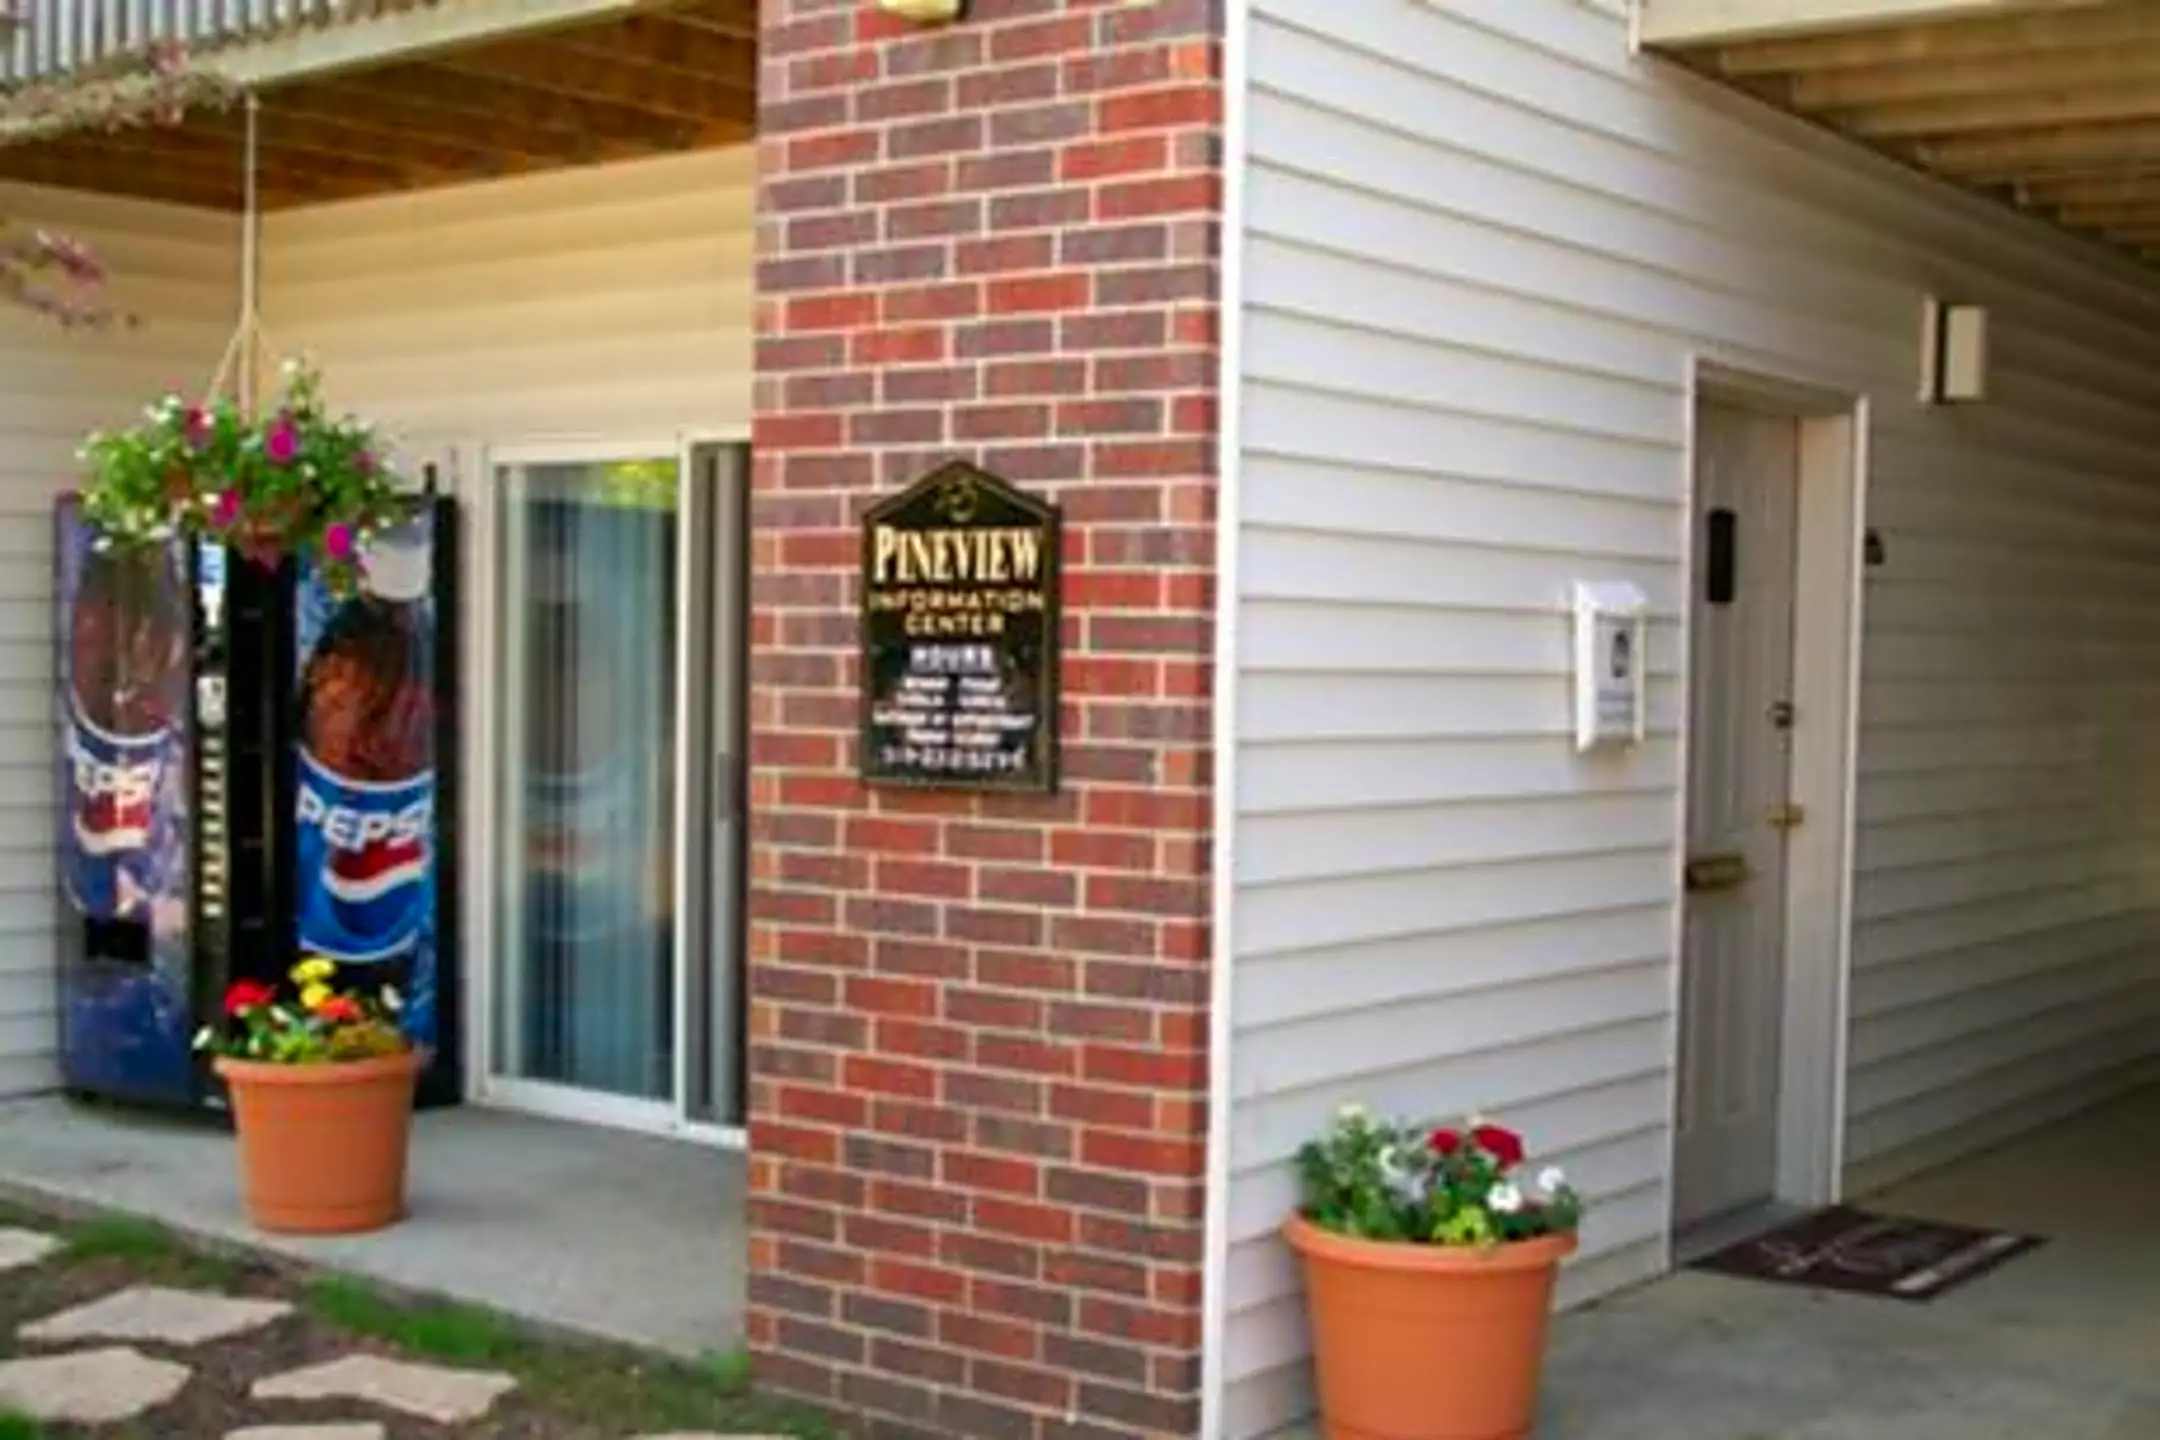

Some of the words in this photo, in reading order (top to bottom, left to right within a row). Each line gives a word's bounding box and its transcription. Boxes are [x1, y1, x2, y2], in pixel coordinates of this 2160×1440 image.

[872, 525, 1042, 582] PINEVIEW
[868, 588, 1045, 614] INFORMATION
[904, 612, 1005, 636] CENTER
